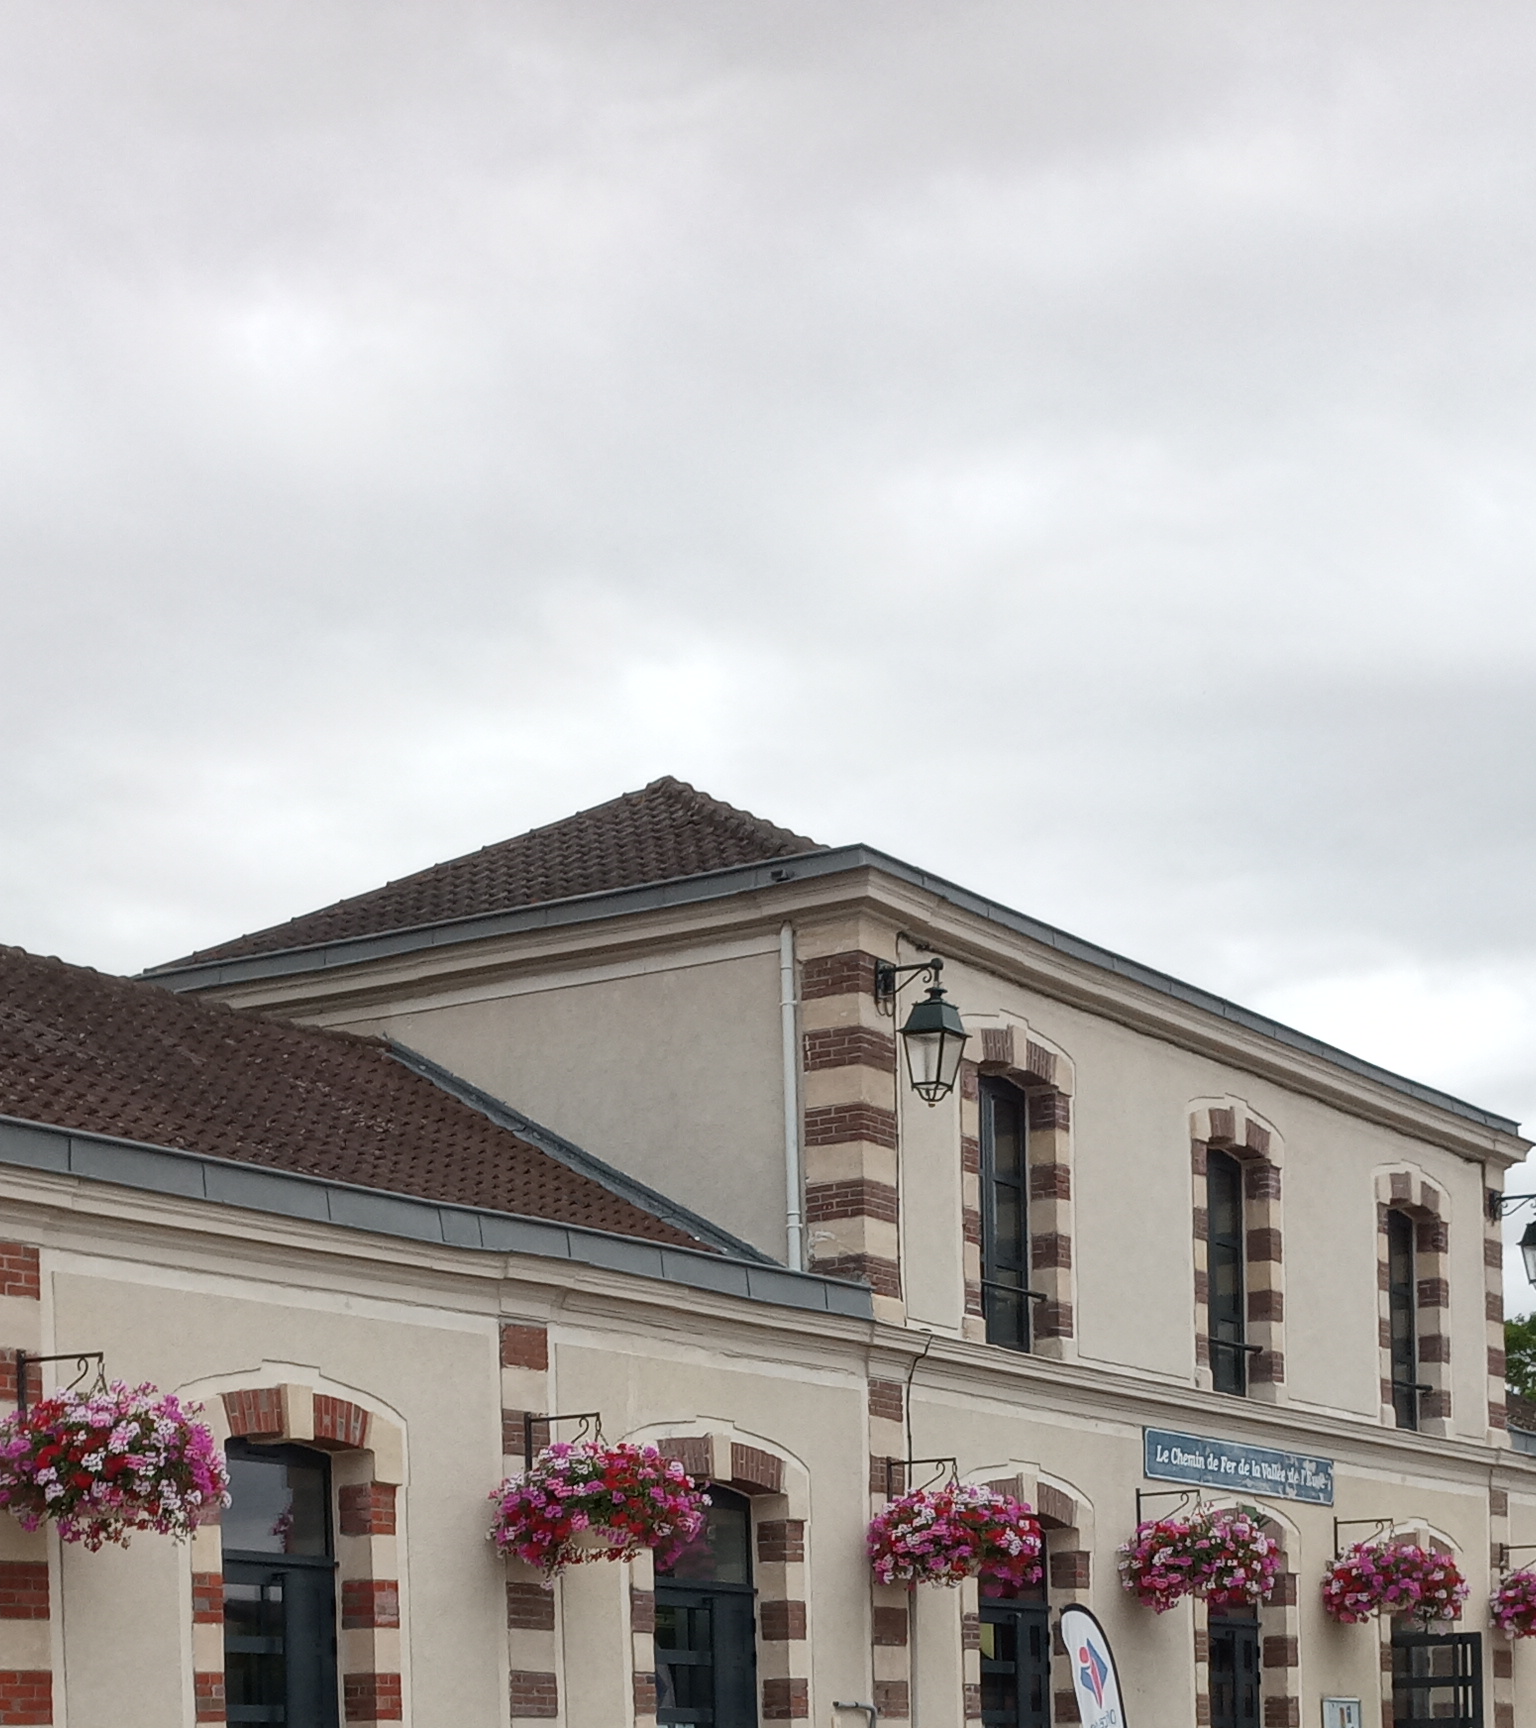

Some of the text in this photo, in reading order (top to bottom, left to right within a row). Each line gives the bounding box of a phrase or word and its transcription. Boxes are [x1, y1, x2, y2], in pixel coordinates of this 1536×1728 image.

[1155, 1444, 1169, 1463] Le
[1171, 1447, 1205, 1469] Chemin
[1207, 1453, 1219, 1471] de
[1220, 1456, 1237, 1474] Fer
[1238, 1458, 1250, 1476] de
[1251, 1460, 1262, 1478] la
